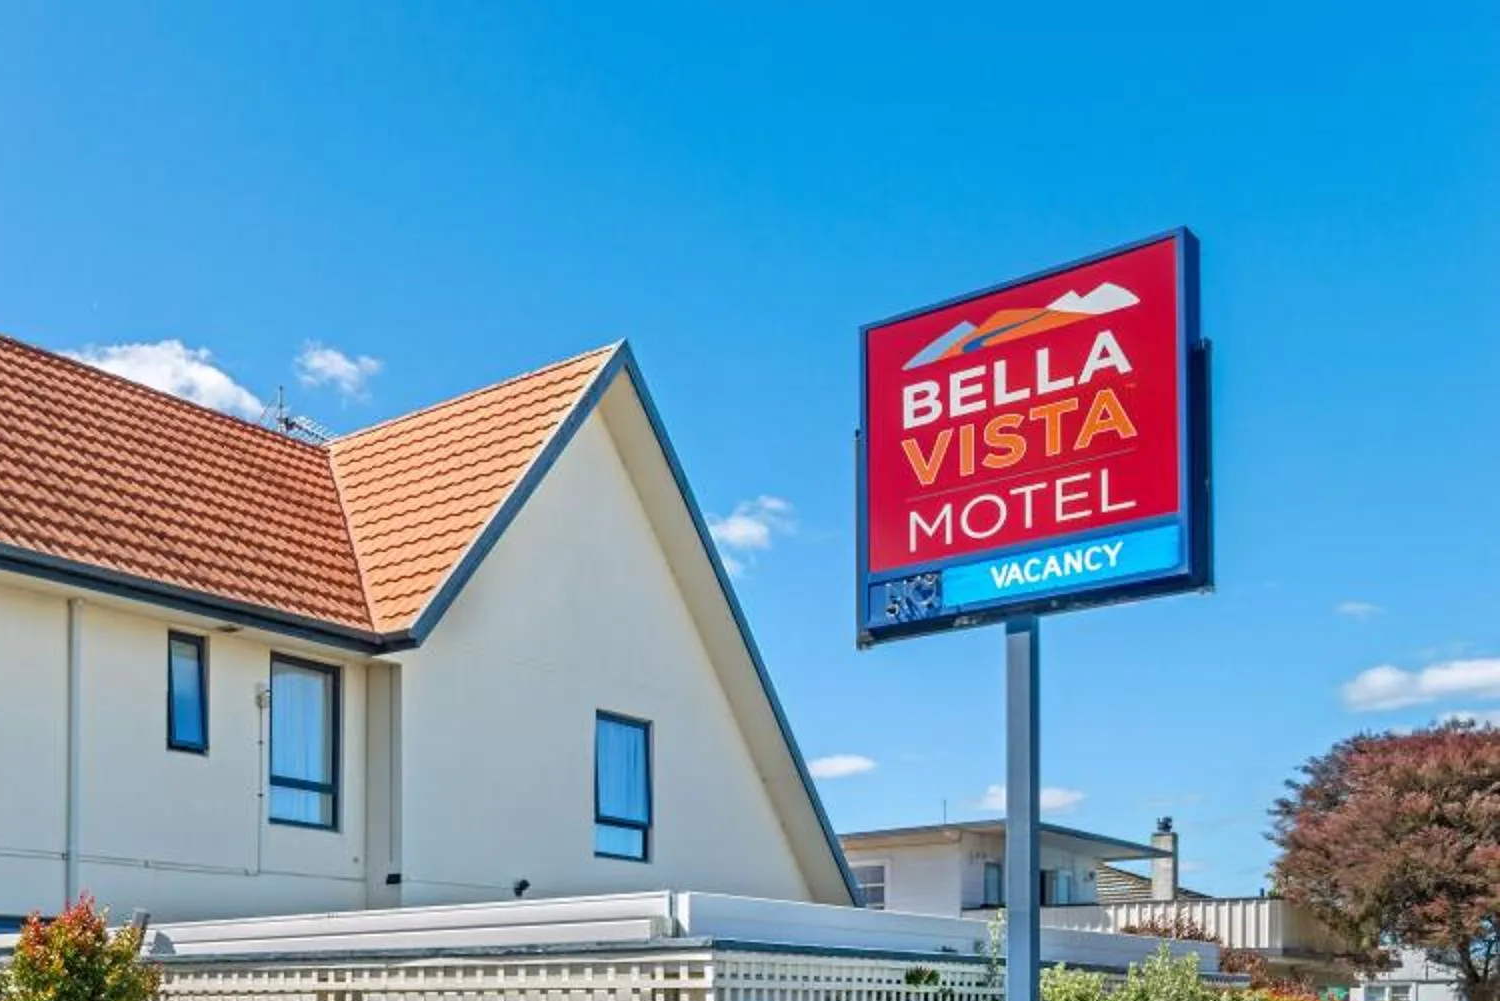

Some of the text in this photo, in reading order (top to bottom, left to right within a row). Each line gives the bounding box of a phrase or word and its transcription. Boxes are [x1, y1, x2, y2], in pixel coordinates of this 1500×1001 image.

[903, 330, 1132, 429] BELLA
[902, 388, 1137, 485] VISTA
[908, 468, 1137, 552] MOTEL
[990, 541, 1124, 588] VACANCY
